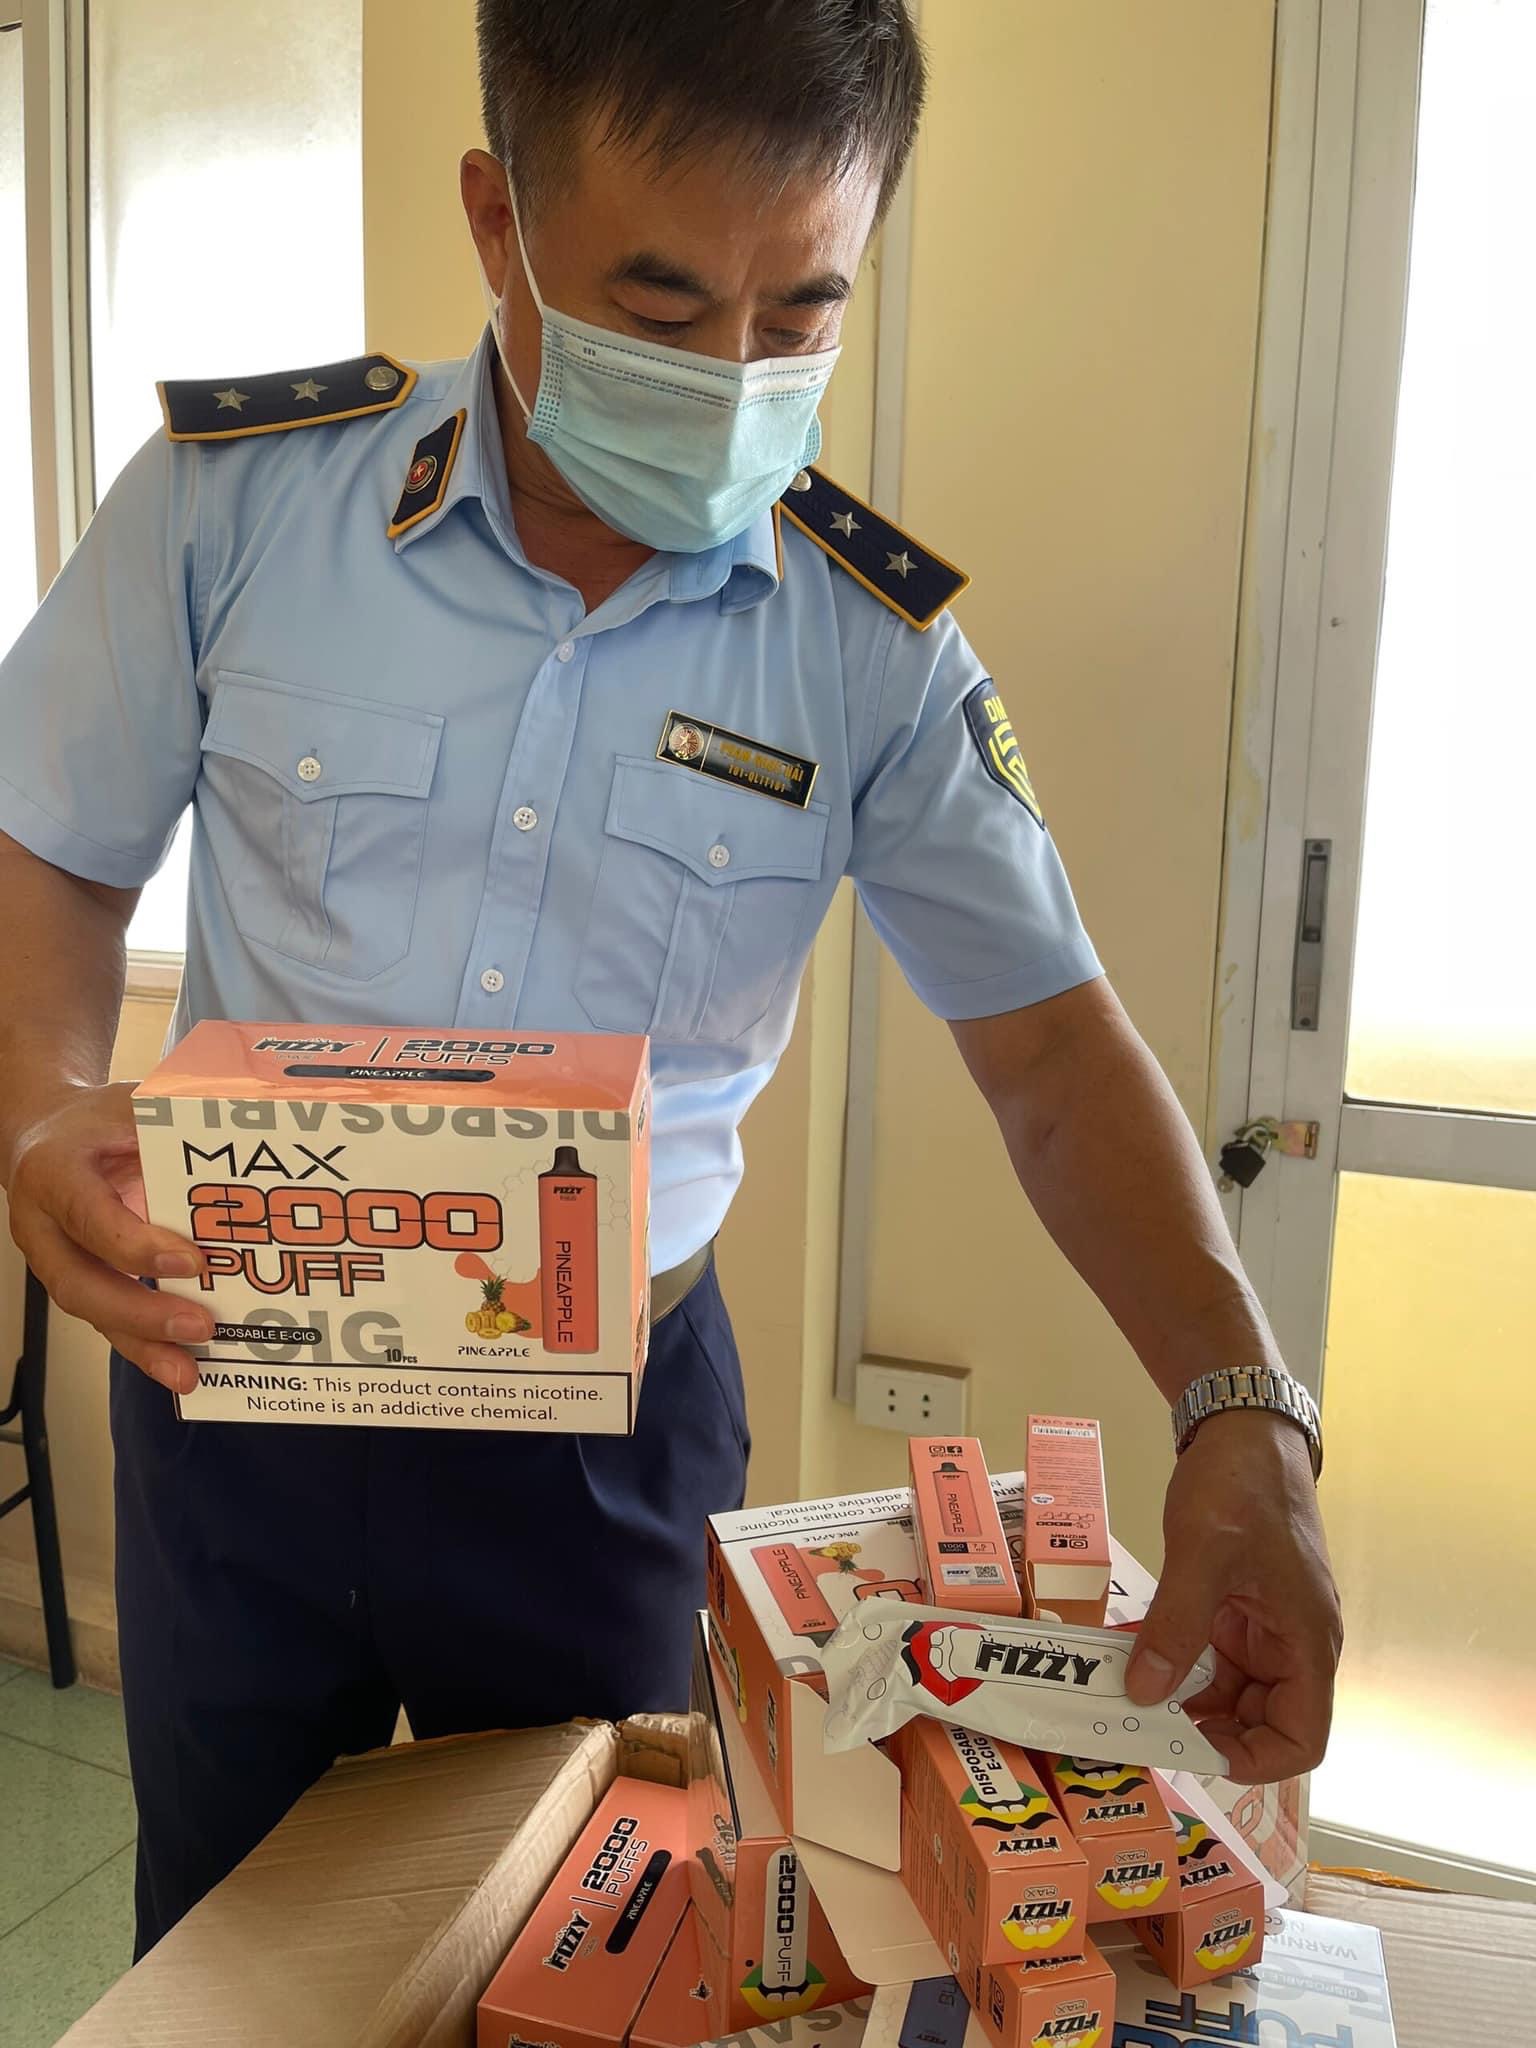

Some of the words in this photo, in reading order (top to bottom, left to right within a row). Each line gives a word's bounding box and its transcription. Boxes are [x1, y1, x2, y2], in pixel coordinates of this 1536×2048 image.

[254, 1037, 354, 1053] FIZZY
[402, 1038, 556, 1055] 2000
[395, 1051, 512, 1065] PUFFS
[350, 1068, 427, 1078] PINEAPPLE
[183, 1139, 350, 1182] MAX
[187, 1183, 504, 1252] 2000
[198, 1246, 385, 1297] PUFF
[556, 1240, 574, 1344] PINEAPPLE
[280, 1330, 316, 1342] E-CIG
[384, 1348, 402, 1363] 10
[457, 1345, 531, 1358] PINEAPPLE
[199, 1372, 308, 1392] WARNING:
[314, 1377, 351, 1393] This
[358, 1379, 431, 1396] product
[438, 1382, 517, 1400] contains
[523, 1385, 604, 1401] nicotine.
[247, 1396, 326, 1412] Nicotine
[332, 1399, 346, 1414] is
[352, 1402, 374, 1414] an
[380, 1401, 465, 1417] addictive
[471, 1403, 558, 1421] chemical.
[766, 1502, 834, 1518] chemical.
[838, 1492, 903, 1508] addictive
[735, 1516, 800, 1532] nicotine.
[804, 1508, 865, 1523] contains
[803, 1530, 861, 1544] PINEAPPLE
[771, 1548, 809, 1601] PINEAPPLE
[974, 1634, 1101, 1686] FIZZY
[973, 1736, 1003, 1771] E-CIG
[1080, 1802, 1147, 1823] FIZZY
[582, 1817, 638, 1891] 2000
[994, 1836, 1061, 1855] FIZZY
[1117, 1850, 1148, 1862] MAX
[605, 1839, 648, 1896] PUFFS
[1098, 1862, 1165, 1887] FIZZY
[1179, 1862, 1234, 1889] FIZZY
[626, 1880, 653, 1920] PINEAPPLE
[776, 1854, 798, 1935] 2000
[1026, 1887, 1057, 1898] MAX
[1004, 1899, 1073, 1924] FIZZY
[545, 1909, 591, 1971] FIZZY
[1197, 1919, 1254, 1951] FIZZY
[776, 1935, 794, 1983] PUFF
[1057, 2003, 1085, 2015] MAX
[1036, 2012, 1100, 2040] FIZZY
